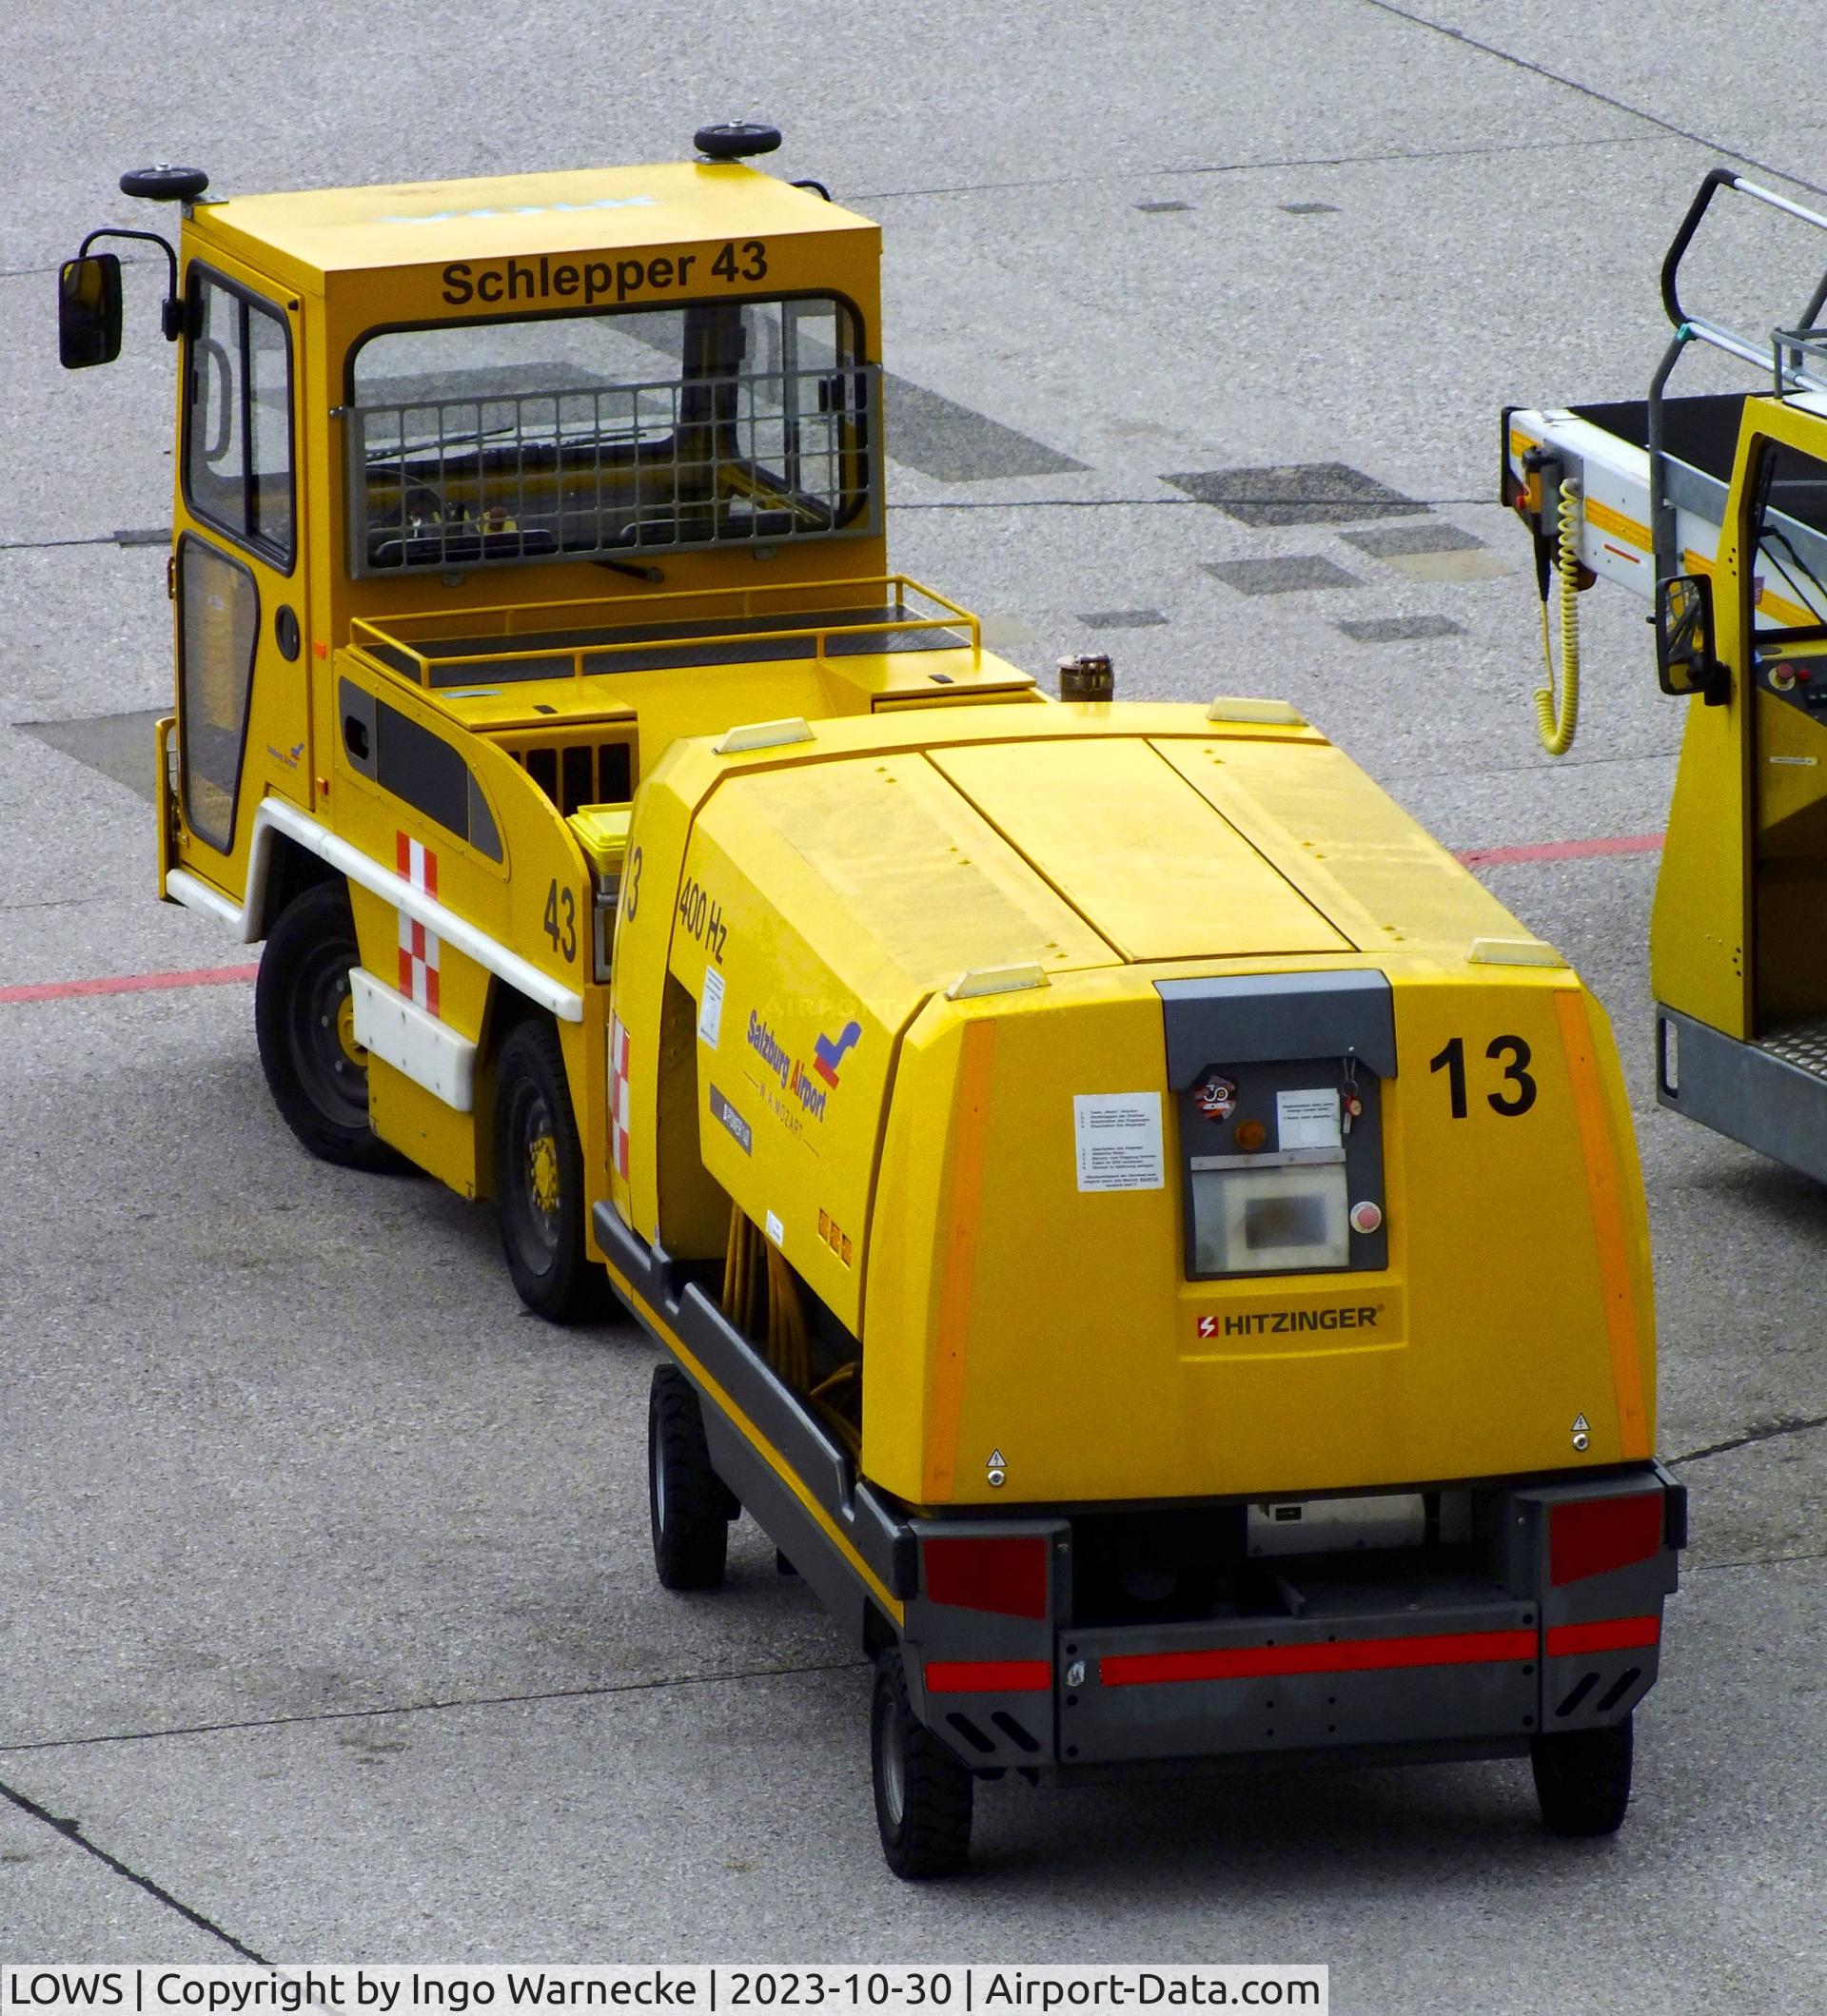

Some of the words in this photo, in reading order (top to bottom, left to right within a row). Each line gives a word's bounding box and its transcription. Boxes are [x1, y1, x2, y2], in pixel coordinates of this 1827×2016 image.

[442, 255, 696, 305] Schlepper
[711, 241, 767, 283] 43
[543, 877, 577, 964] 43
[679, 876, 707, 942] 400
[705, 900, 728, 966] Hz
[747, 1008, 791, 1089] Salzburg
[790, 1058, 826, 1124] Airport
[1430, 1034, 1537, 1119] 13
